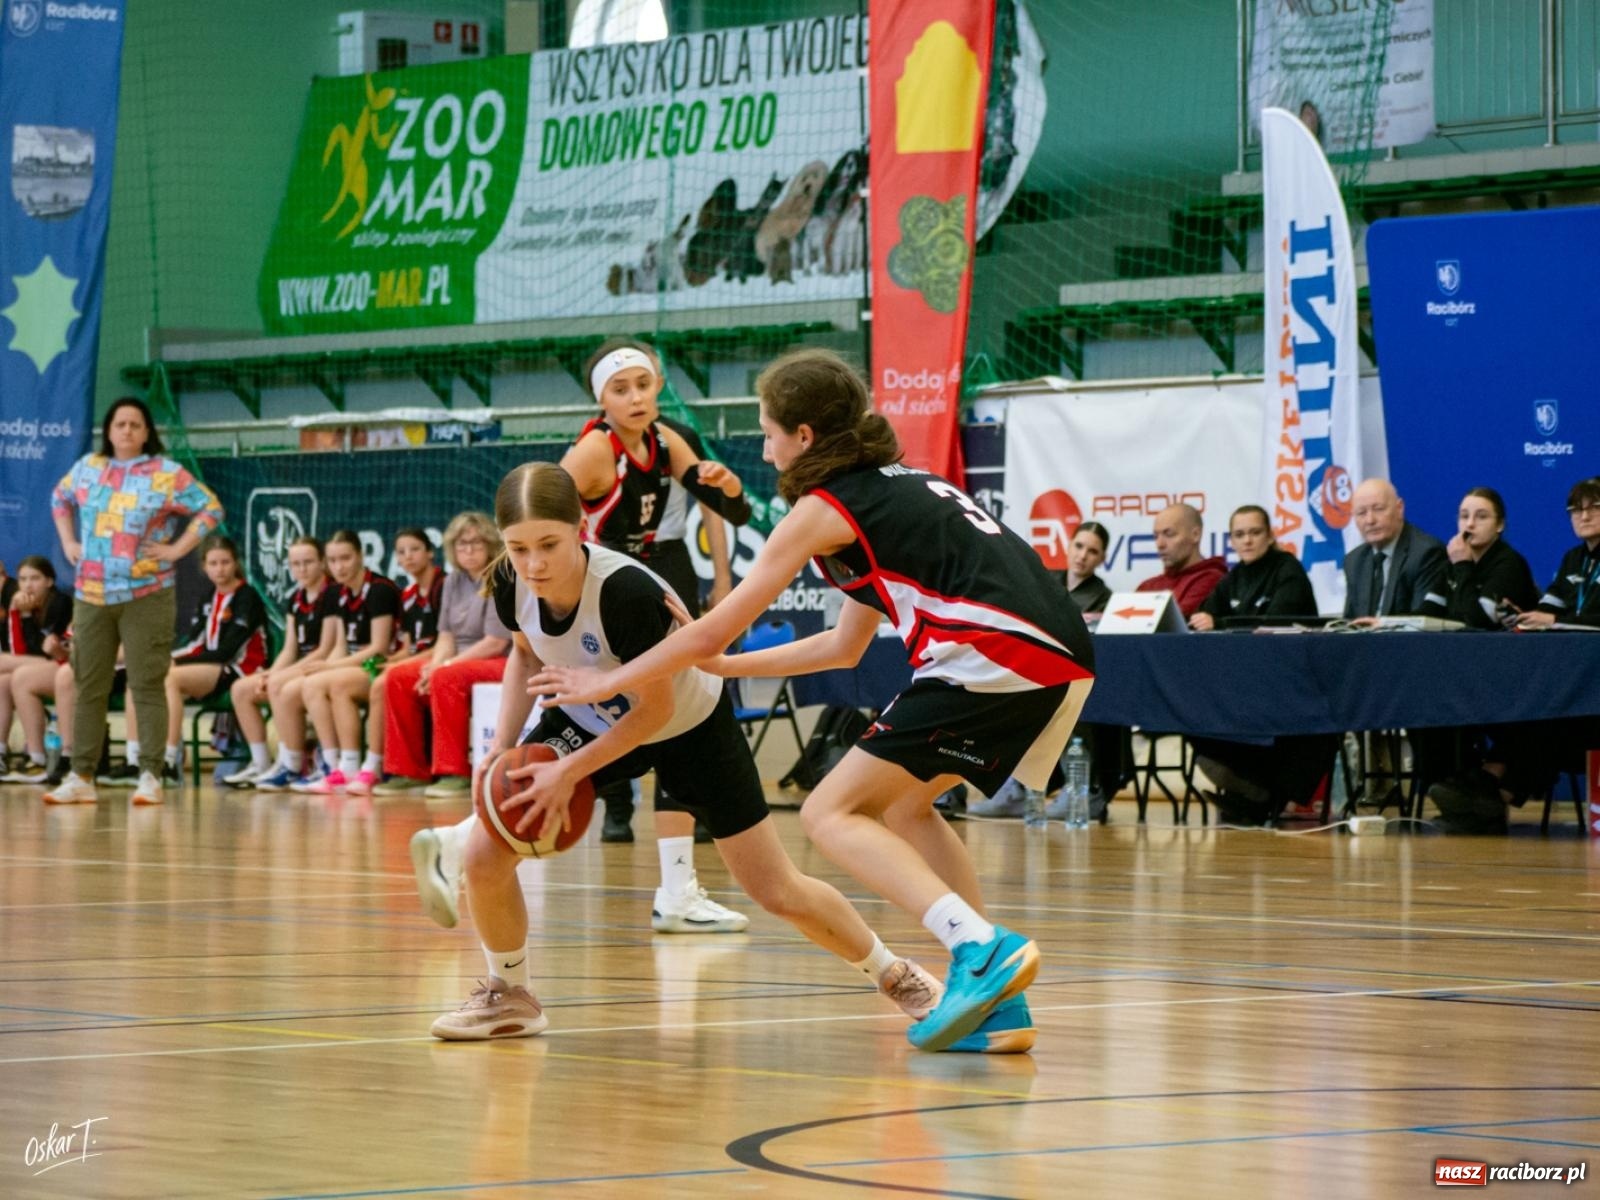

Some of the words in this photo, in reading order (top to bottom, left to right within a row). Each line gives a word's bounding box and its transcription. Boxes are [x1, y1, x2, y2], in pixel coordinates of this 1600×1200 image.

[46, 2, 117, 21] Racibórz
[549, 36, 690, 106] WSZYSTKO
[700, 30, 752, 88] DLA
[387, 89, 506, 161] ZOO
[539, 100, 707, 171] DOMOWEGO
[713, 92, 778, 152] ZOO
[362, 160, 493, 226] MAR
[278, 264, 451, 316] WWW.ZOO-MAR.PL
[1426, 301, 1476, 315] Racibórz
[41, 419, 72, 437] coś
[882, 394, 907, 416] od
[1524, 442, 1574, 456] Racibórz
[926, 480, 1002, 535] 3
